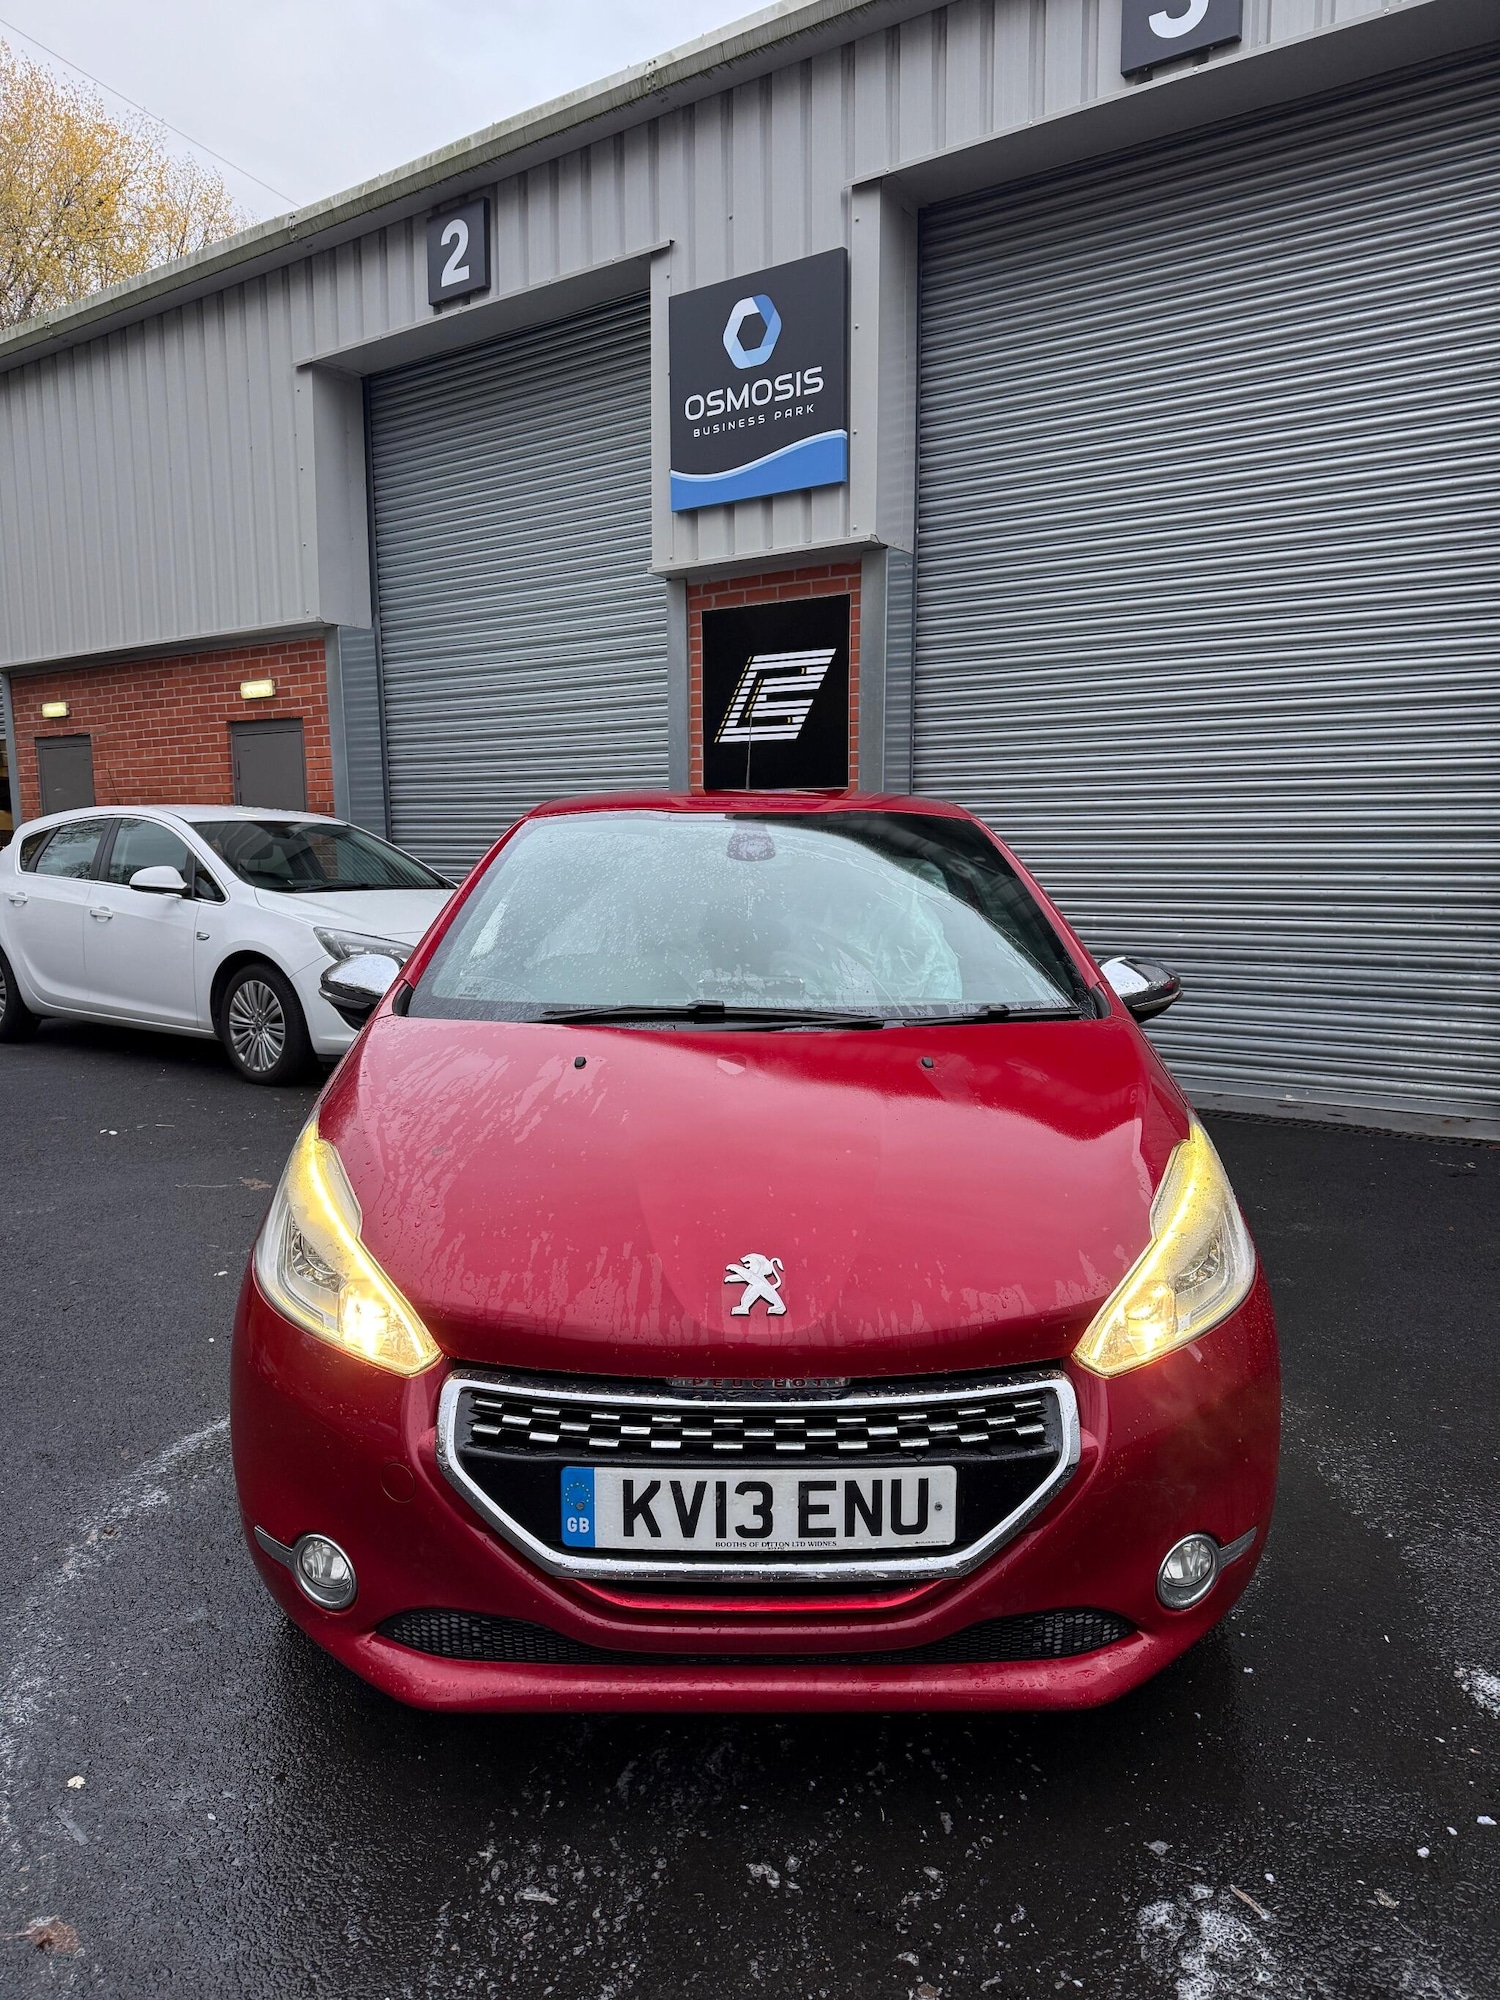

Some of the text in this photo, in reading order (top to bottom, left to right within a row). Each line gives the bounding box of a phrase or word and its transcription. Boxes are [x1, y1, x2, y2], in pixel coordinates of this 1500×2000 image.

[440, 218, 470, 288] 2
[684, 366, 825, 421] OSMOSIS
[693, 403, 816, 438] BUSINESS PARK
[566, 1516, 590, 1534] GB
[622, 1477, 929, 1539] KV13 ENU
